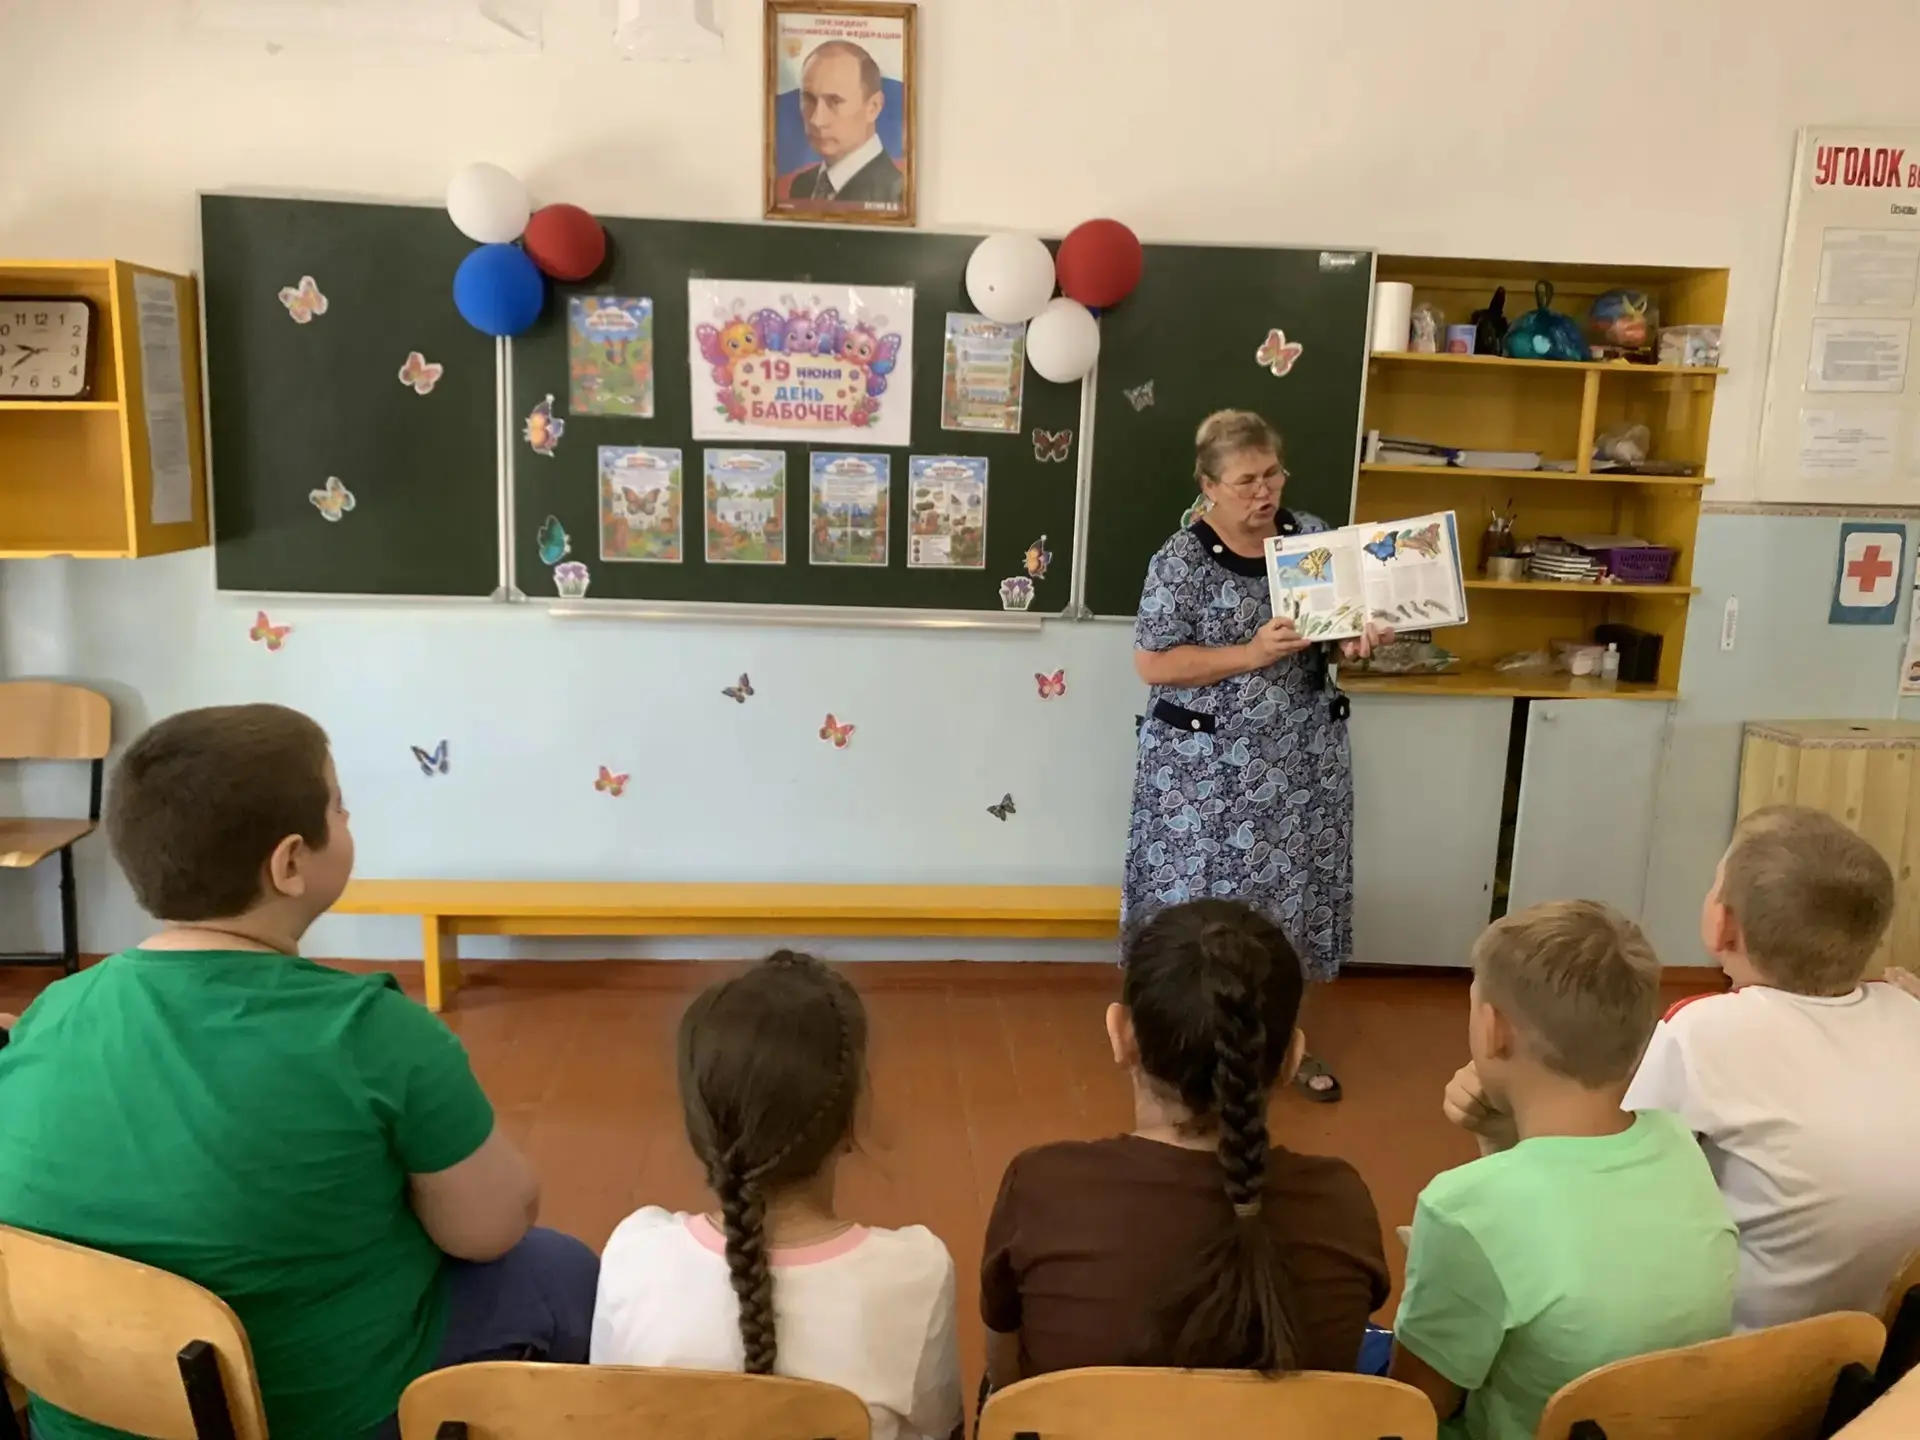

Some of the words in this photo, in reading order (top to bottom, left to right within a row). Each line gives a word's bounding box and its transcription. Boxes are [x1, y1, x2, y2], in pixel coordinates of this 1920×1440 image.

[1815, 146, 1905, 187] УГОЛОК
[34, 312, 48, 326] 12
[72, 324, 82, 337] 2
[70, 344, 80, 358] 3
[69, 364, 78, 376] 4
[760, 359, 790, 380] 19
[10, 375, 19, 388] 7
[29, 375, 39, 388] 6
[52, 375, 61, 389] 5
[774, 386, 824, 402] ДЕНЬ
[752, 400, 848, 421] БАБОЧЕК
